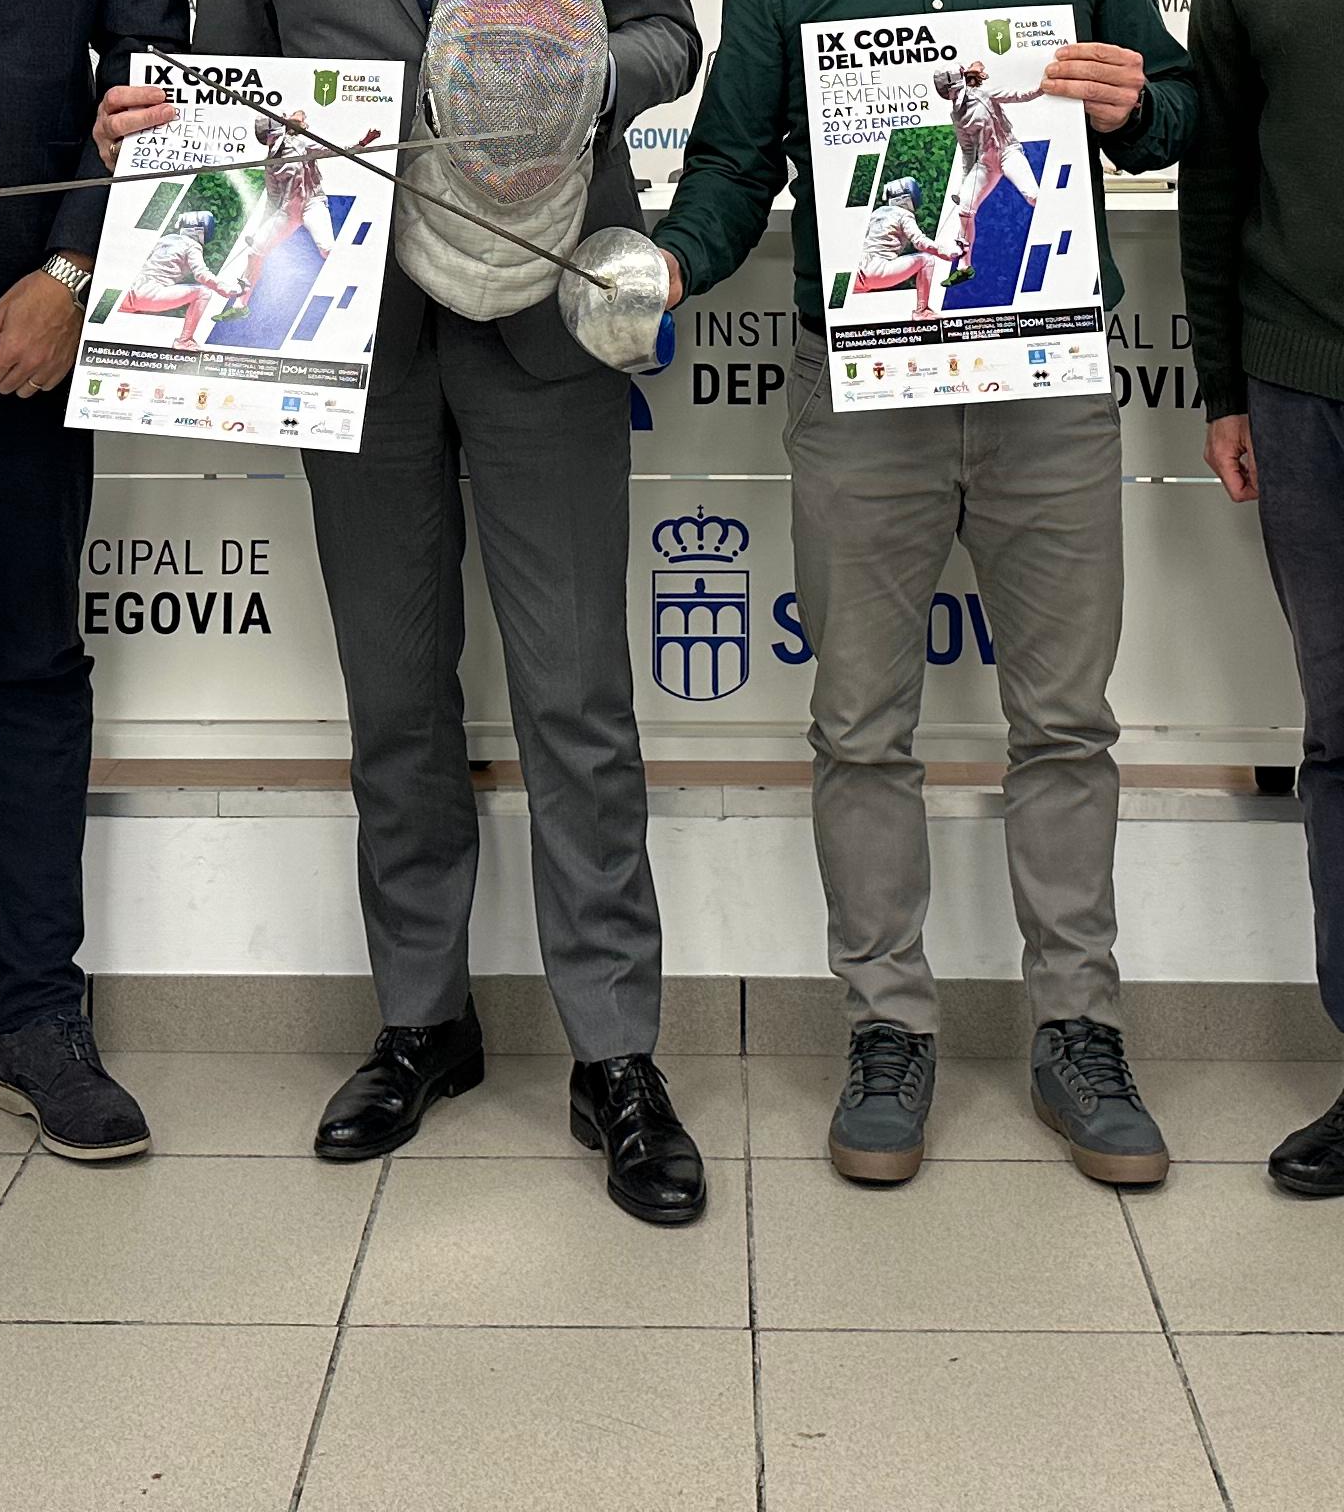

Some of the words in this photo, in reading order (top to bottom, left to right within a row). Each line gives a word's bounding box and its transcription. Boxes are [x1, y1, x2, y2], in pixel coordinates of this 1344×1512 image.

[817, 32, 846, 52] IX
[854, 26, 936, 49] COPA
[819, 53, 862, 70] DEL
[870, 45, 957, 67] MUNDO
[145, 66, 173, 85] IX
[183, 67, 263, 87] COPA
[820, 70, 882, 89] SABLE
[165, 88, 188, 104] EL
[196, 89, 282, 106] MUNDO
[822, 84, 927, 105] FEMENINO
[822, 107, 858, 118] CAT.
[866, 101, 929, 115] JUNIOR
[823, 121, 839, 133] 20
[842, 120, 852, 130] Y
[855, 119, 867, 129] 21
[872, 115, 921, 128] ENERO
[629, 127, 690, 149] GOVIA
[824, 131, 887, 146] SEGOVIA
[133, 148, 150, 156] 20
[155, 149, 166, 158] Y
[168, 150, 179, 160] 21
[943, 320, 962, 328] SAB
[1020, 318, 1044, 327] DOM
[204, 354, 223, 362] SAB
[283, 366, 307, 374] DOM
[221, 539, 269, 575] DE
[84, 591, 272, 635] EGOVIA
